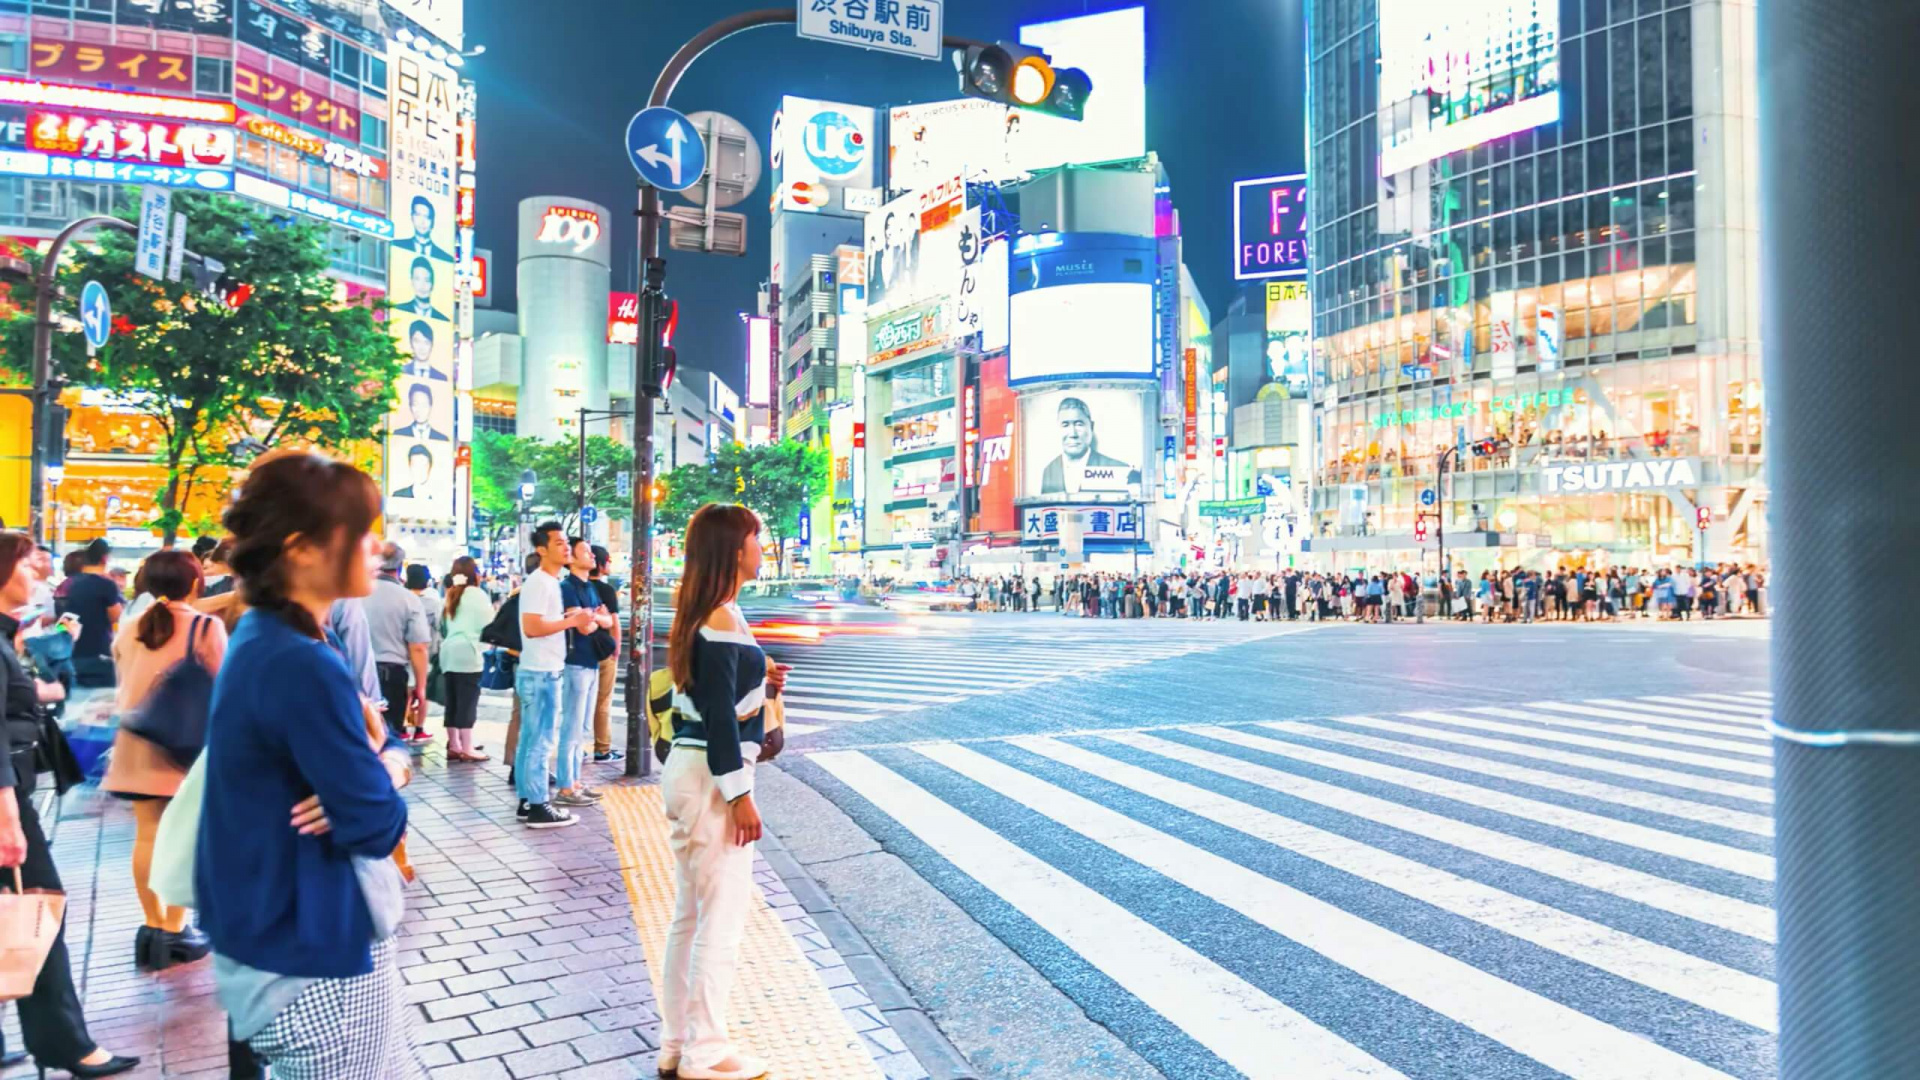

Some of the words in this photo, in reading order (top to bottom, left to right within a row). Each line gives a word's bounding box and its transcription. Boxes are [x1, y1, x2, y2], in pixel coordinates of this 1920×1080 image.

[829, 19, 885, 42] Shibuya
[889, 30, 916, 48] Sta.
[32, 43, 188, 82] プライス
[236, 66, 357, 131] コンタクト
[398, 56, 450, 113] 日本
[82, 117, 179, 162] ガスト
[324, 142, 380, 177] ガスト
[538, 214, 600, 253] 109
[1489, 386, 1575, 412] COFFEE
[1542, 459, 1696, 492] TSUTAYA
[1028, 511, 1137, 533] 大盛書店
